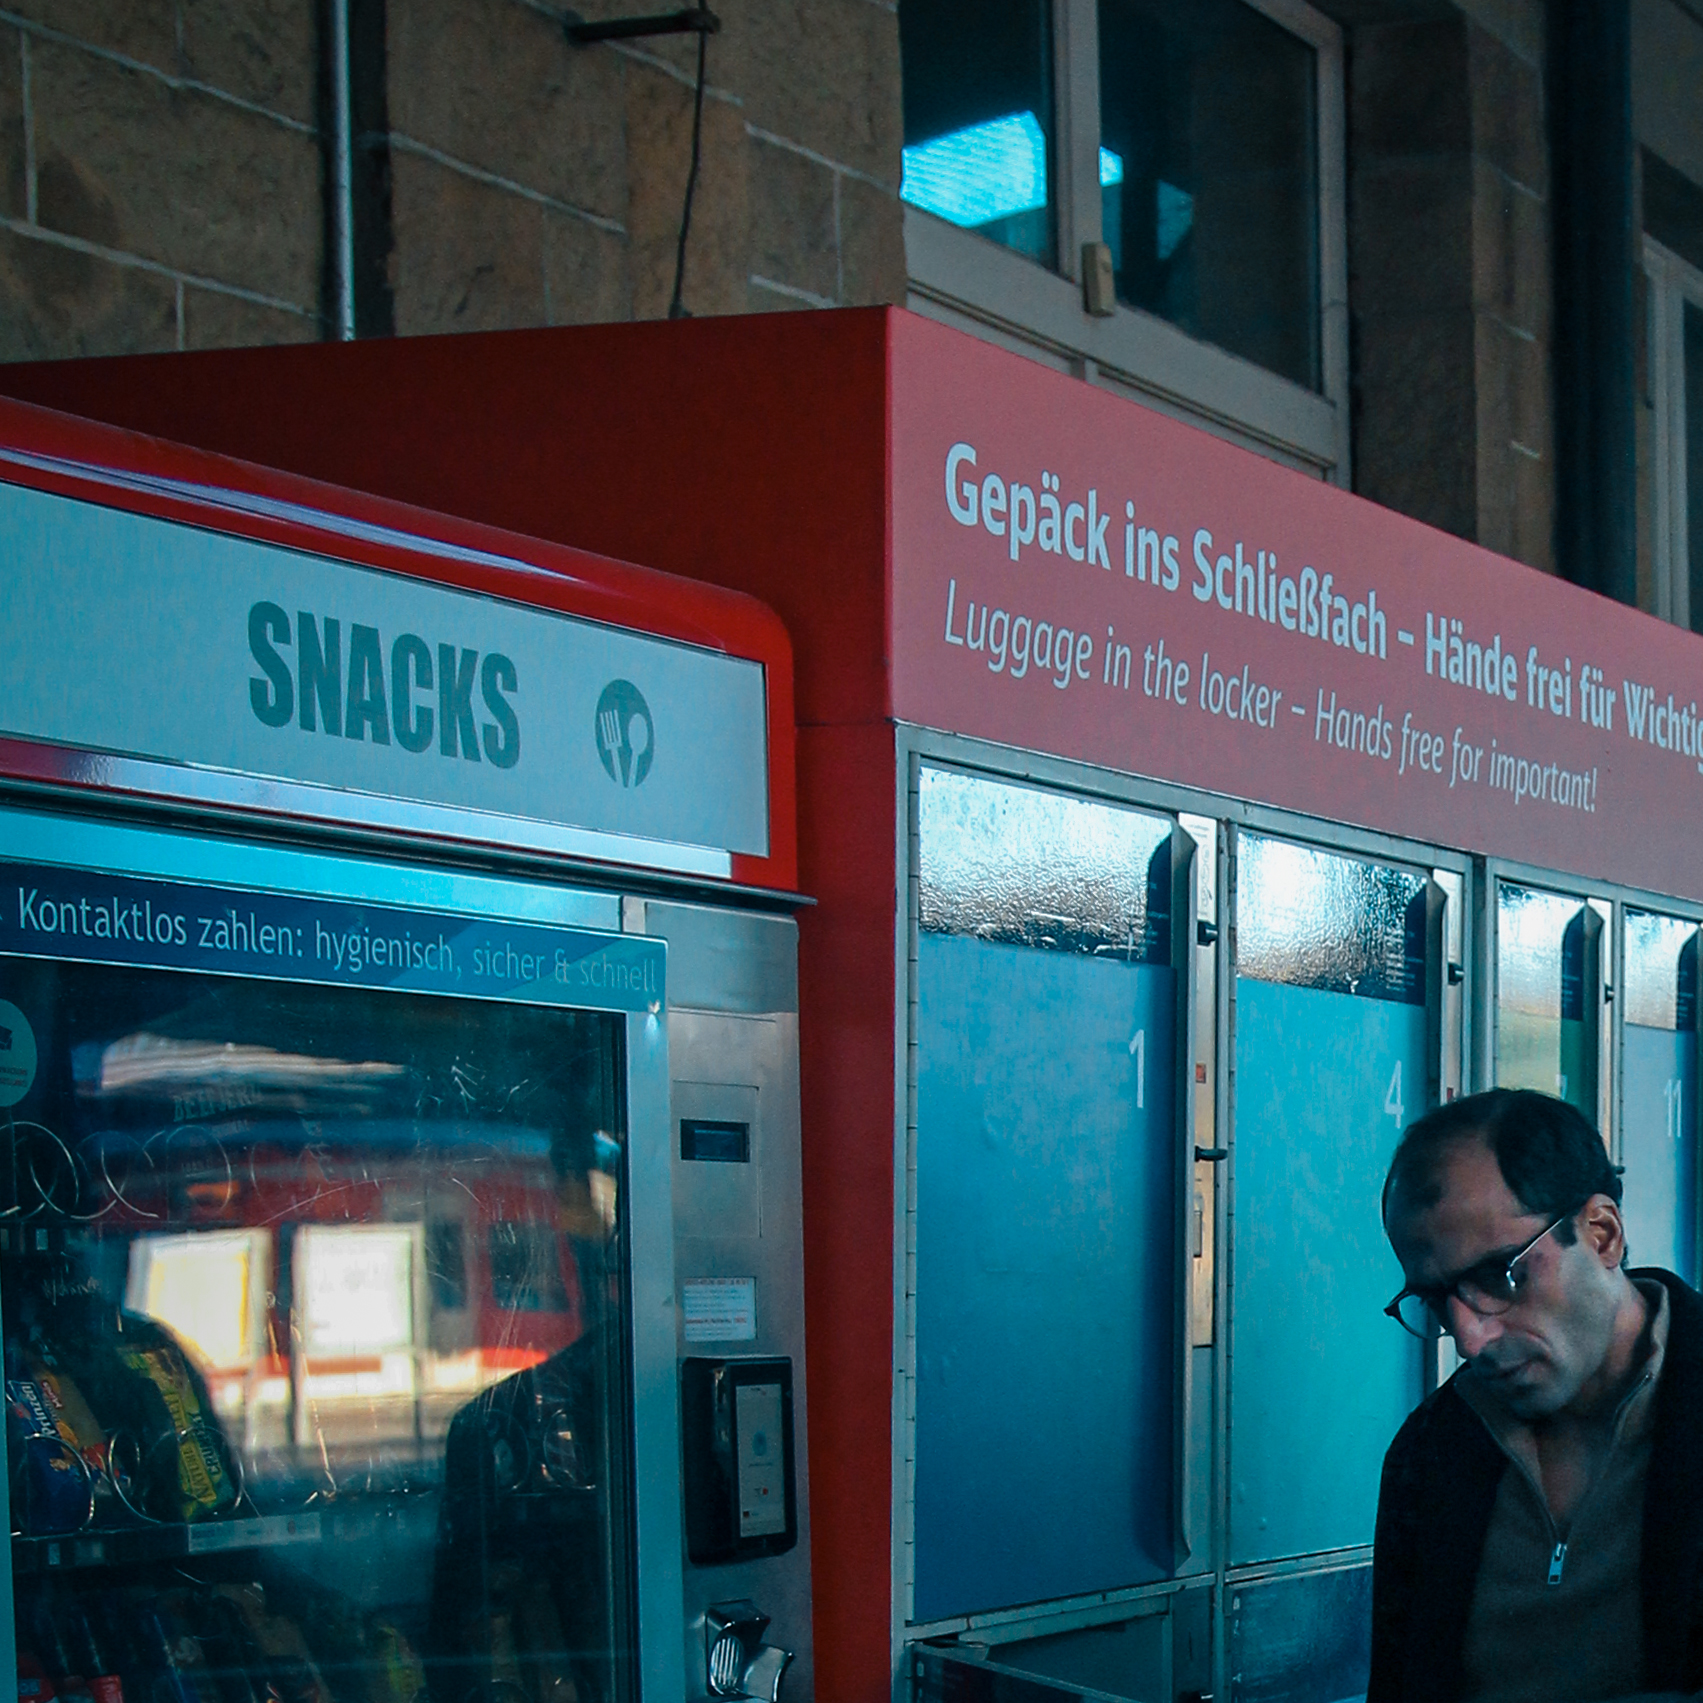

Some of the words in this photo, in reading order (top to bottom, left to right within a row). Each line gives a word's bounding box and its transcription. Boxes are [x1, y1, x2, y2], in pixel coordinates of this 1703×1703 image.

[944, 441, 1111, 571] Gepäck
[1125, 500, 1181, 593] ins
[1192, 528, 1388, 661] Schließfach
[1425, 611, 1519, 704] Hände
[1525, 644, 1573, 720] frei
[1578, 663, 1618, 734] für
[248, 600, 521, 769] SNACKS
[944, 578, 1094, 690] Luggage
[1103, 624, 1133, 691] in
[1143, 638, 1191, 707] the
[1199, 652, 1284, 730] locker
[1315, 686, 1395, 762] Hands
[1399, 709, 1445, 778] free
[1446, 725, 1485, 790] for
[1487, 736, 1600, 815] important!
[19, 887, 187, 946] Kontaktlos
[197, 910, 303, 957] zahlen:
[315, 919, 462, 982] hygienisch,
[473, 940, 545, 979] sicher
[555, 948, 570, 984] &
[580, 953, 656, 993] schnell
[1129, 1029, 1145, 1108] 1
[1384, 1060, 1405, 1129] 4
[1664, 1078, 1682, 1138] 11
[20, 1382, 56, 1436] Prinzen
